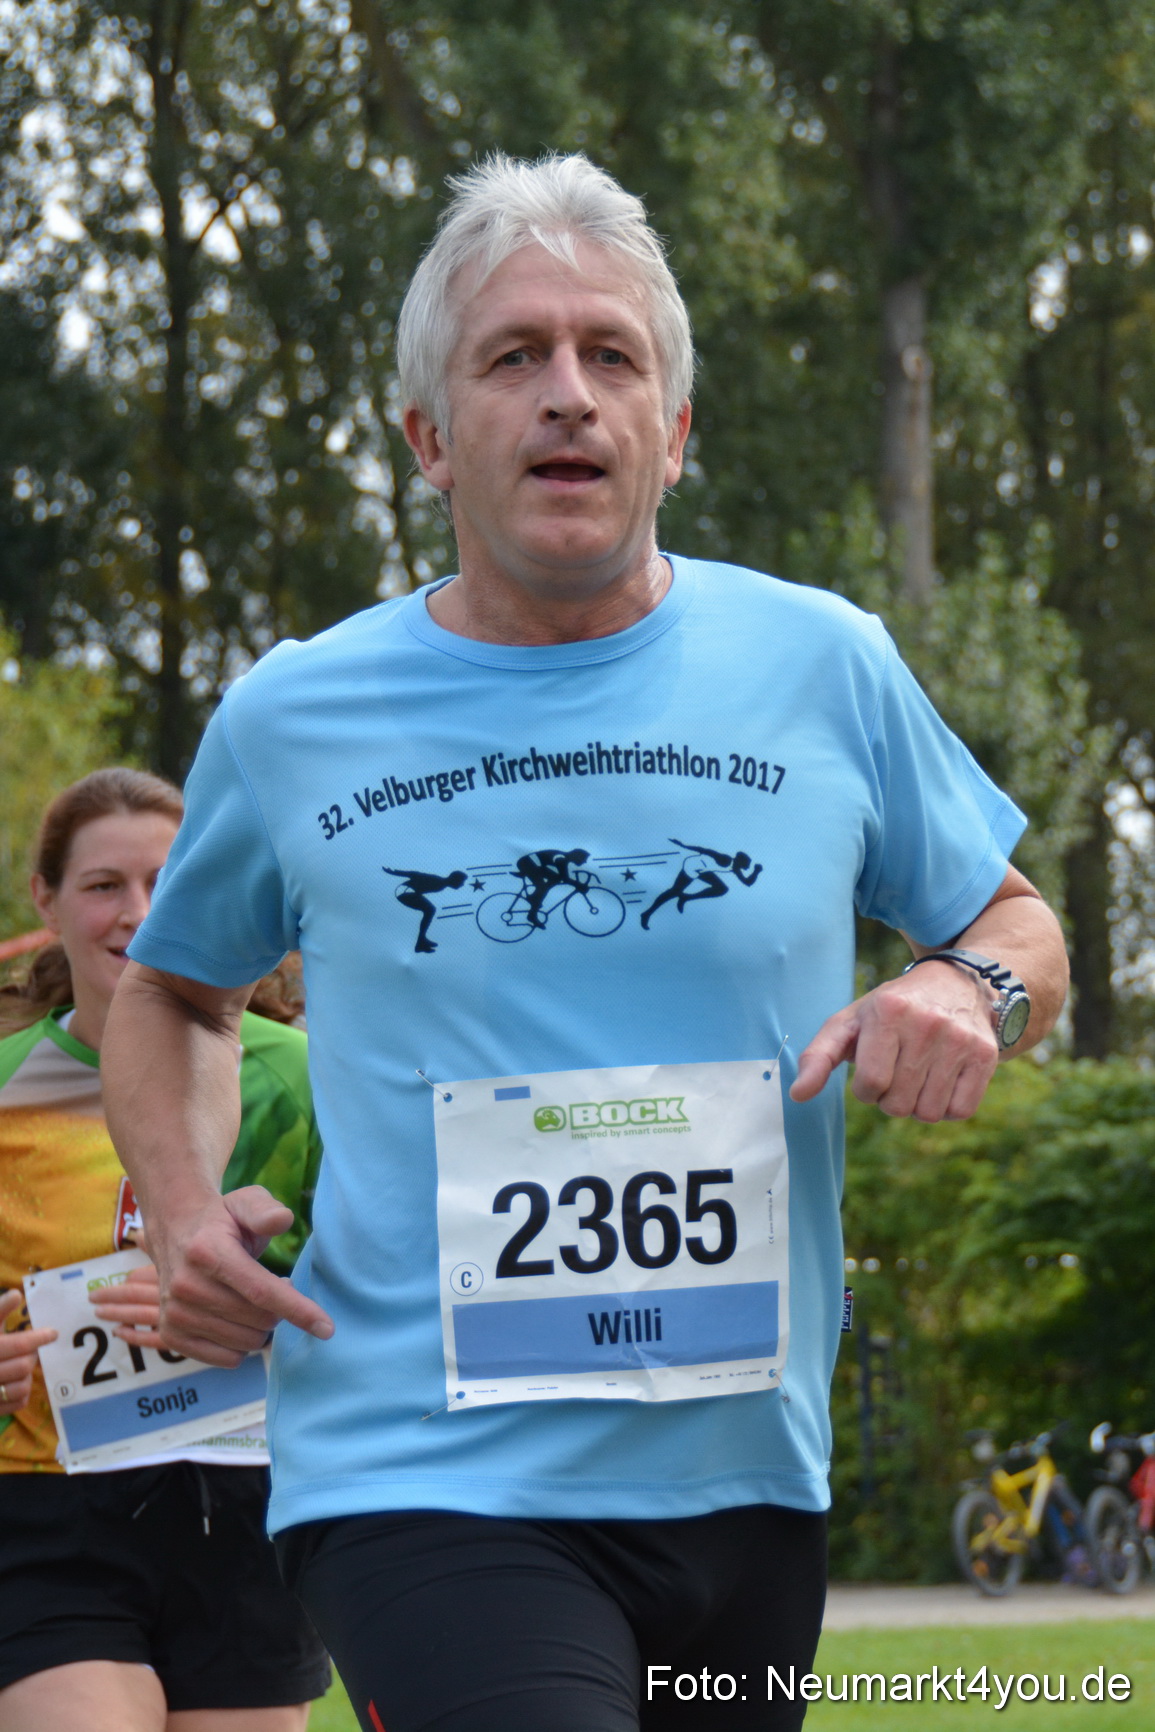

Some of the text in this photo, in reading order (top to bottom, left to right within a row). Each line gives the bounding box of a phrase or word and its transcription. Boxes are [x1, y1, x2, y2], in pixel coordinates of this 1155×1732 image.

[317, 742, 786, 841] 32. Velburger Kirchweihtriathlon 2017
[569, 1097, 690, 1130] BOCK
[571, 1124, 692, 1140] inspired by smart concepts
[492, 1168, 738, 1280] 2365
[460, 1270, 473, 1290] C
[587, 1307, 663, 1346] Willi
[73, 1324, 189, 1387] 21
[137, 1385, 199, 1419] Sonja
